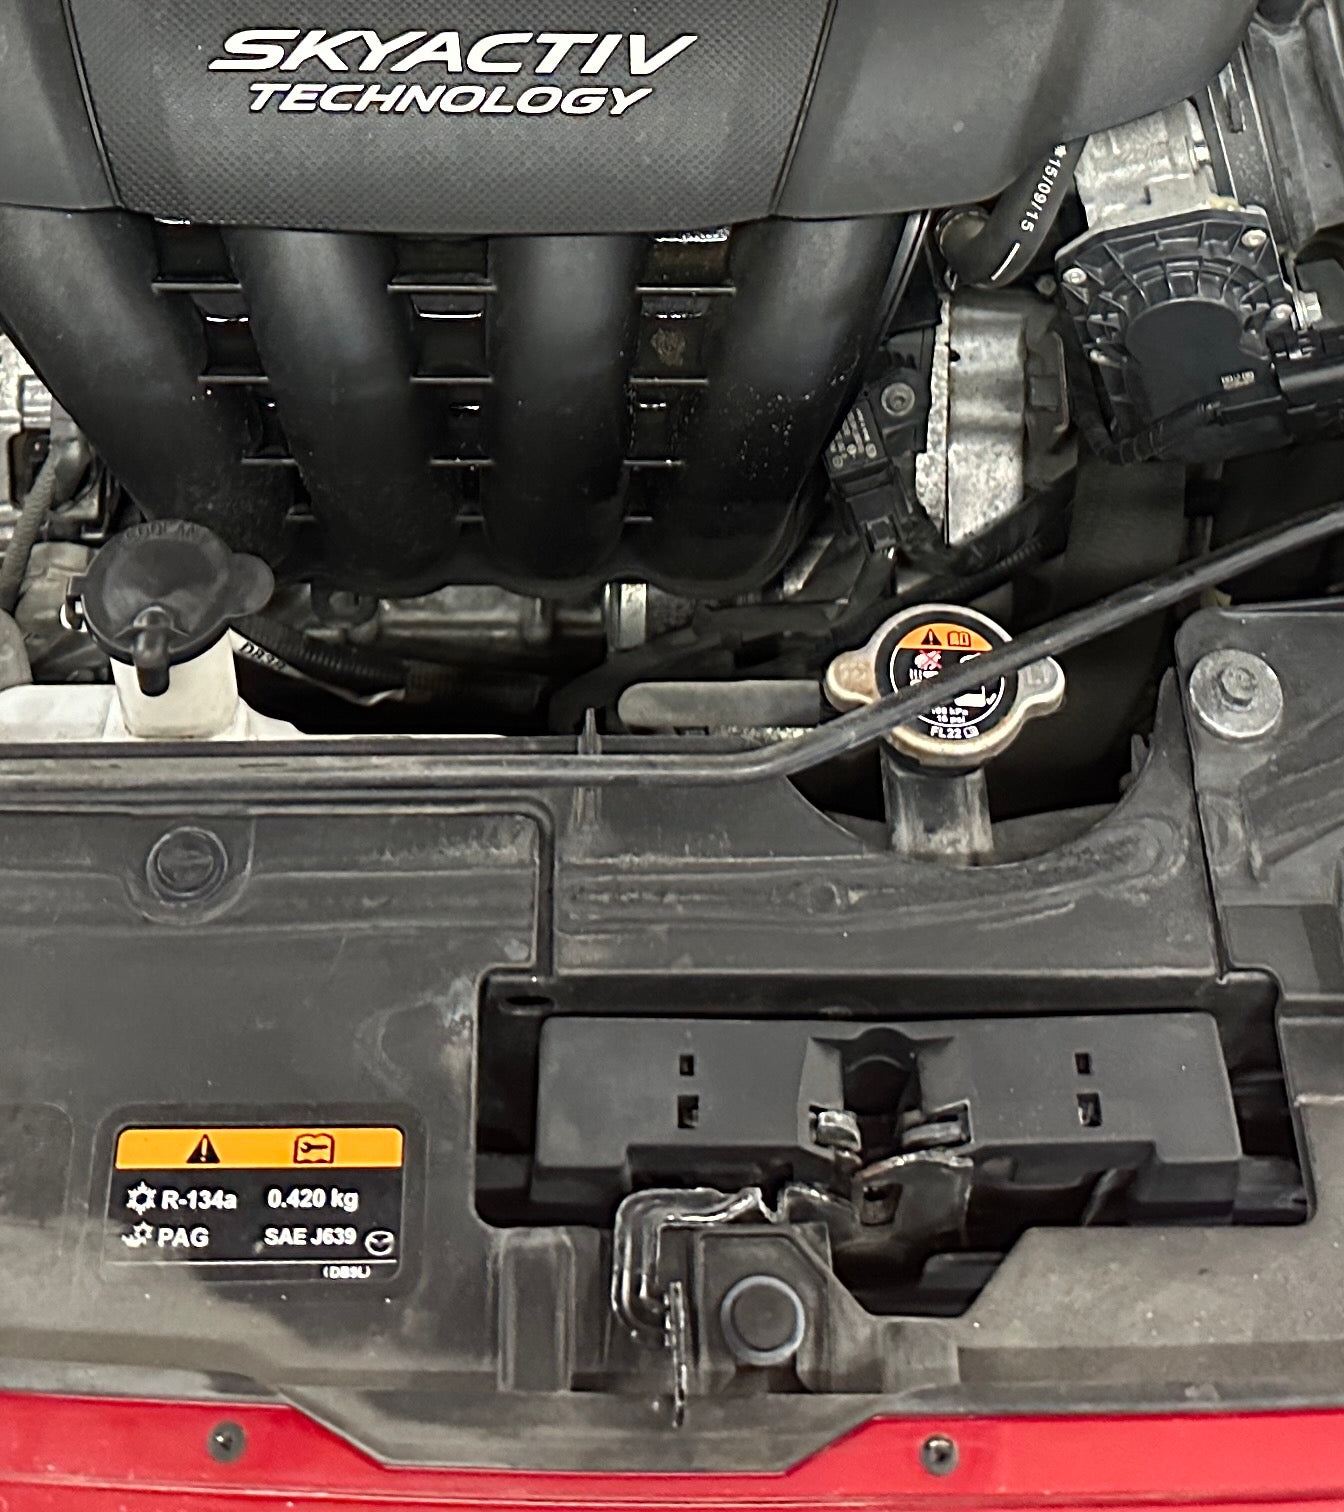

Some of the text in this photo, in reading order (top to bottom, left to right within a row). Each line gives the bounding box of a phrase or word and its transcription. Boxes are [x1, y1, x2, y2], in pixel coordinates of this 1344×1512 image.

[209, 29, 697, 75] SKYACTIV
[248, 82, 653, 115] TECHNOLOGY
[930, 725, 962, 739] FL22
[161, 1188, 360, 1213] R-134a 0.420 kg
[157, 1226, 357, 1248] PAG SAE J639
